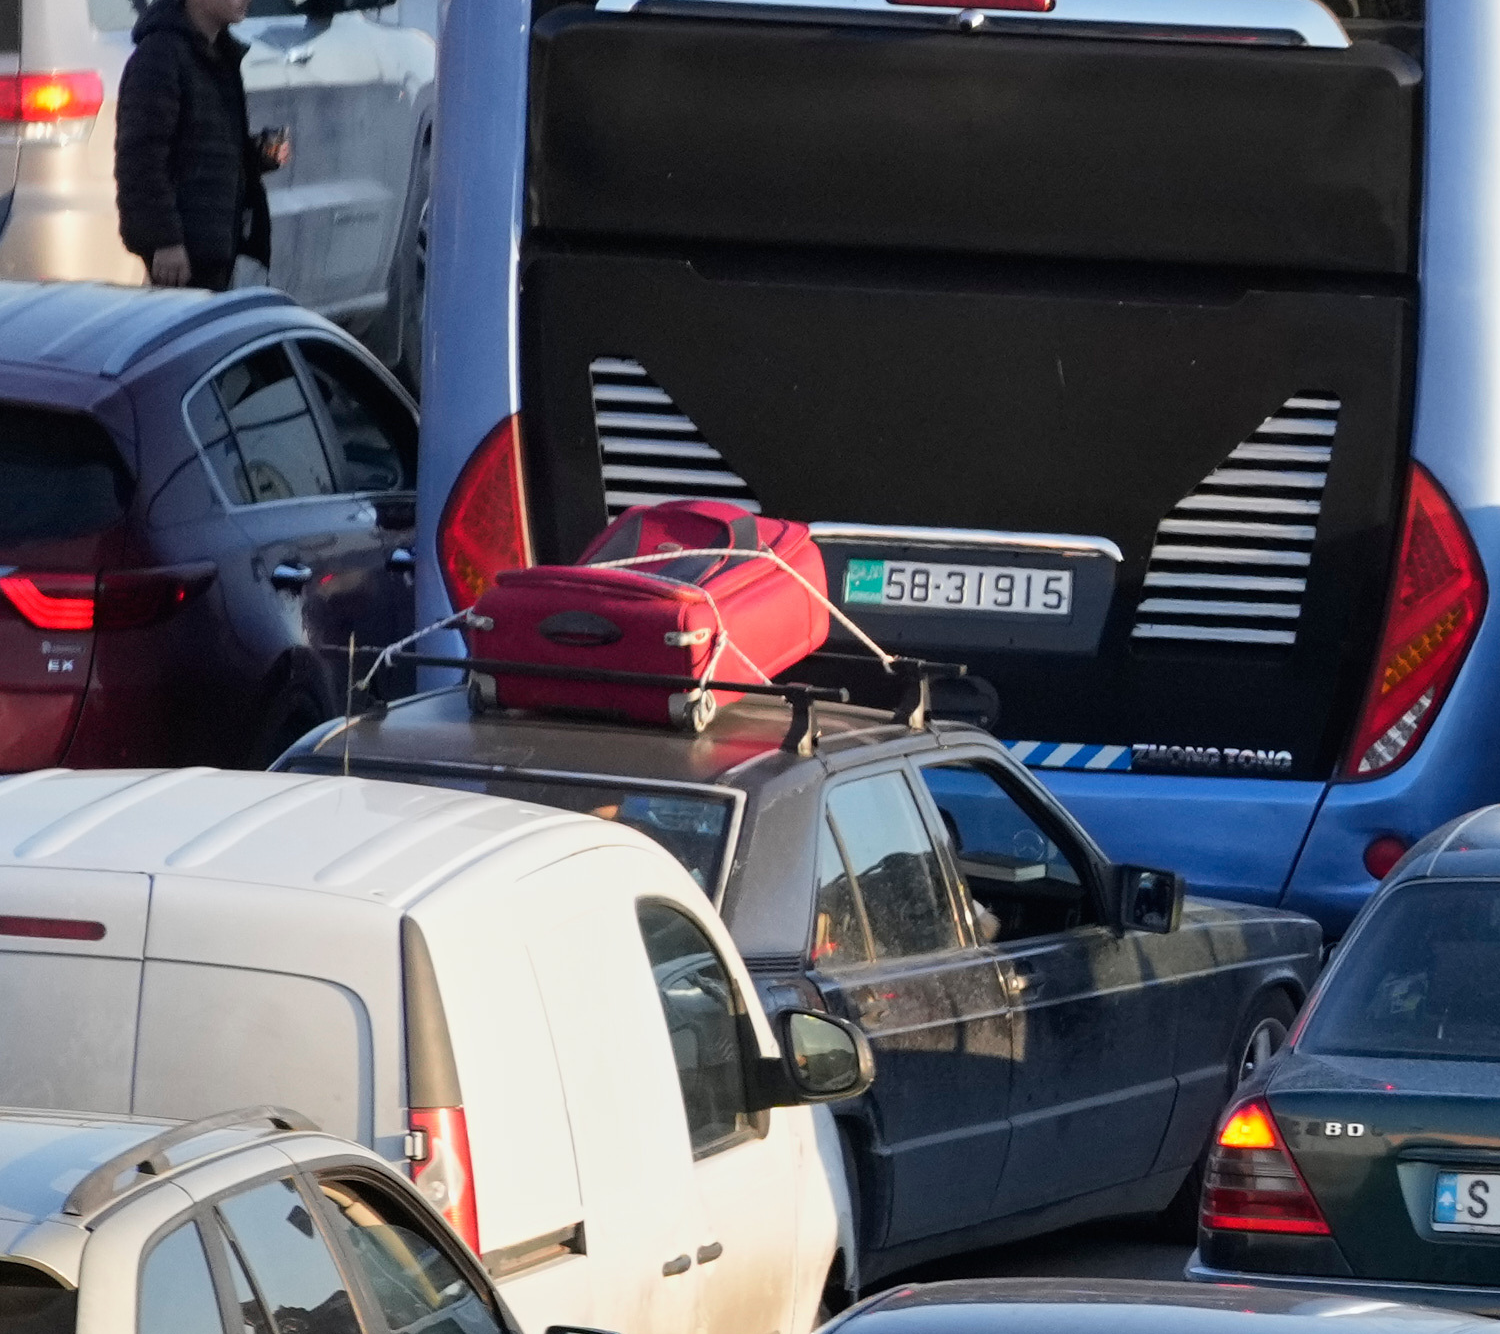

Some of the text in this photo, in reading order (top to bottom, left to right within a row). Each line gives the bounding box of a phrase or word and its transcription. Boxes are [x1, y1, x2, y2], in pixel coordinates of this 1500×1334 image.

[885, 565, 1066, 610] 58-31915
[1132, 743, 1293, 770] ZHONG TONG
[1468, 1180, 1490, 1220] S
